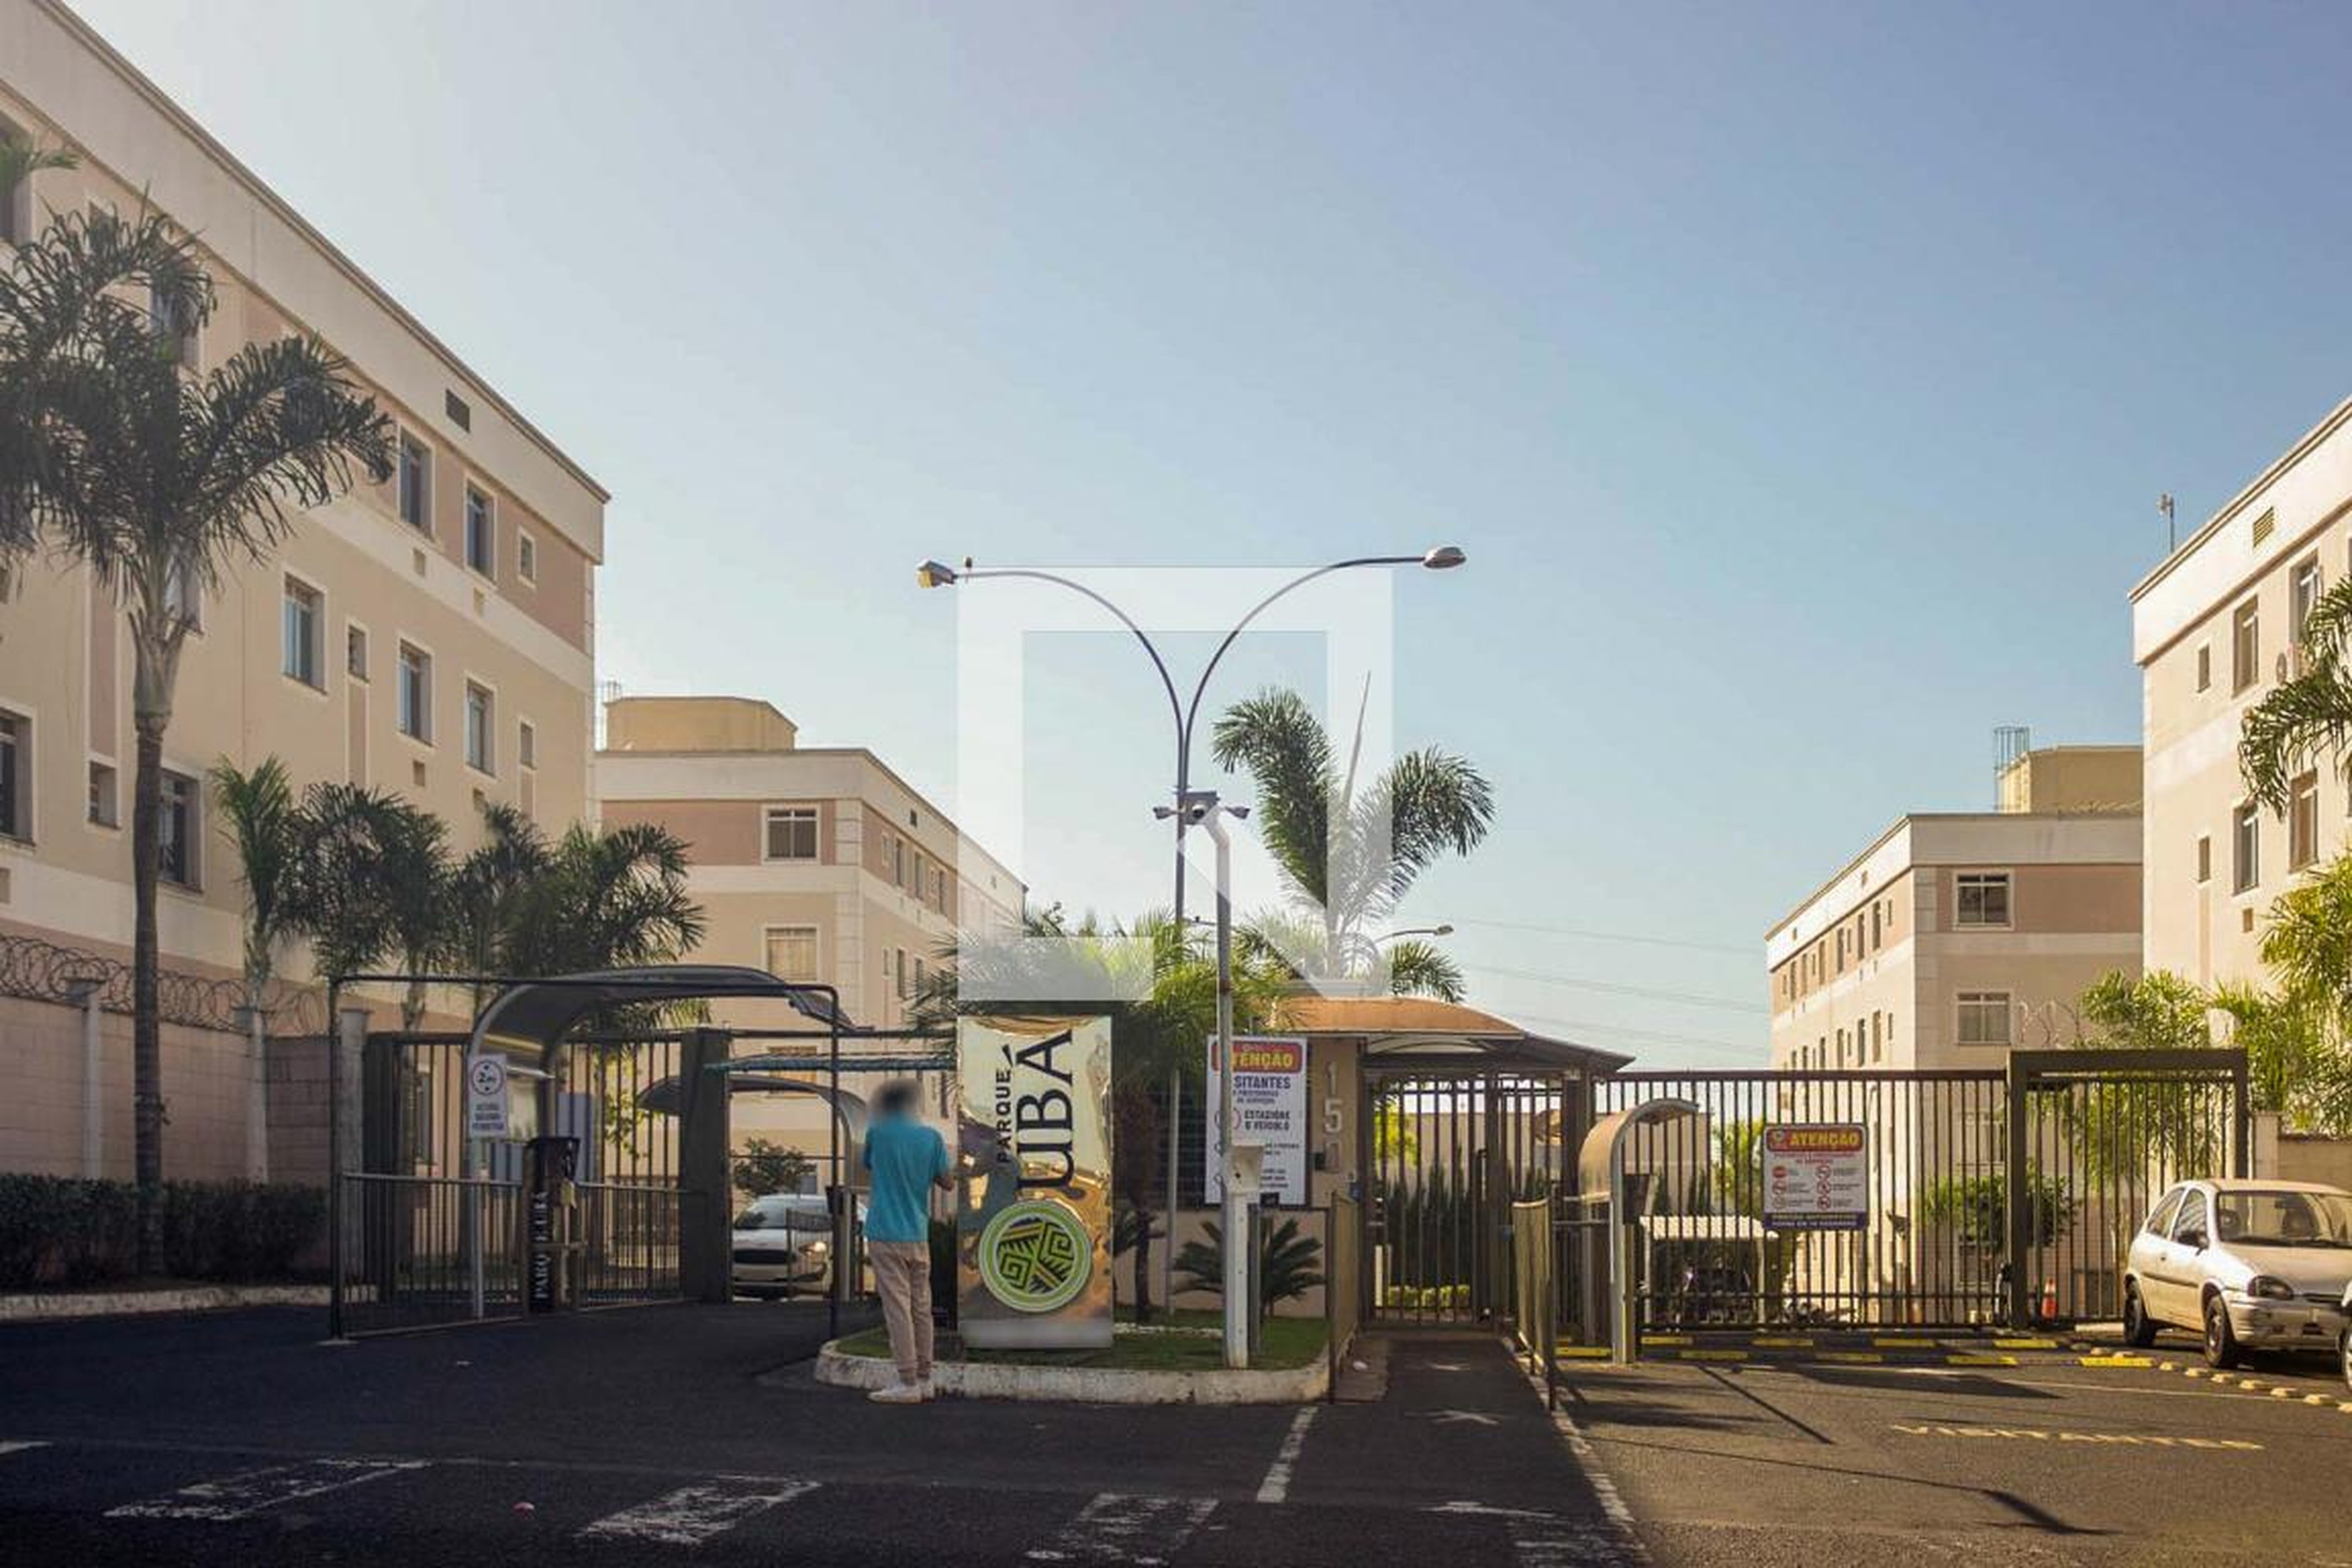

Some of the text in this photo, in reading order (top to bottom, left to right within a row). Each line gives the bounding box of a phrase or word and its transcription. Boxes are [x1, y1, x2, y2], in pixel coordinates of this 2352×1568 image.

[1231, 1049, 1294, 1070] TENÇÃO
[1234, 1076, 1291, 1089] SITANTES
[996, 1068, 1011, 1163] PARQUE
[1001, 1029, 1074, 1189] UBÁ
[533, 1231, 551, 1299] PARQE
